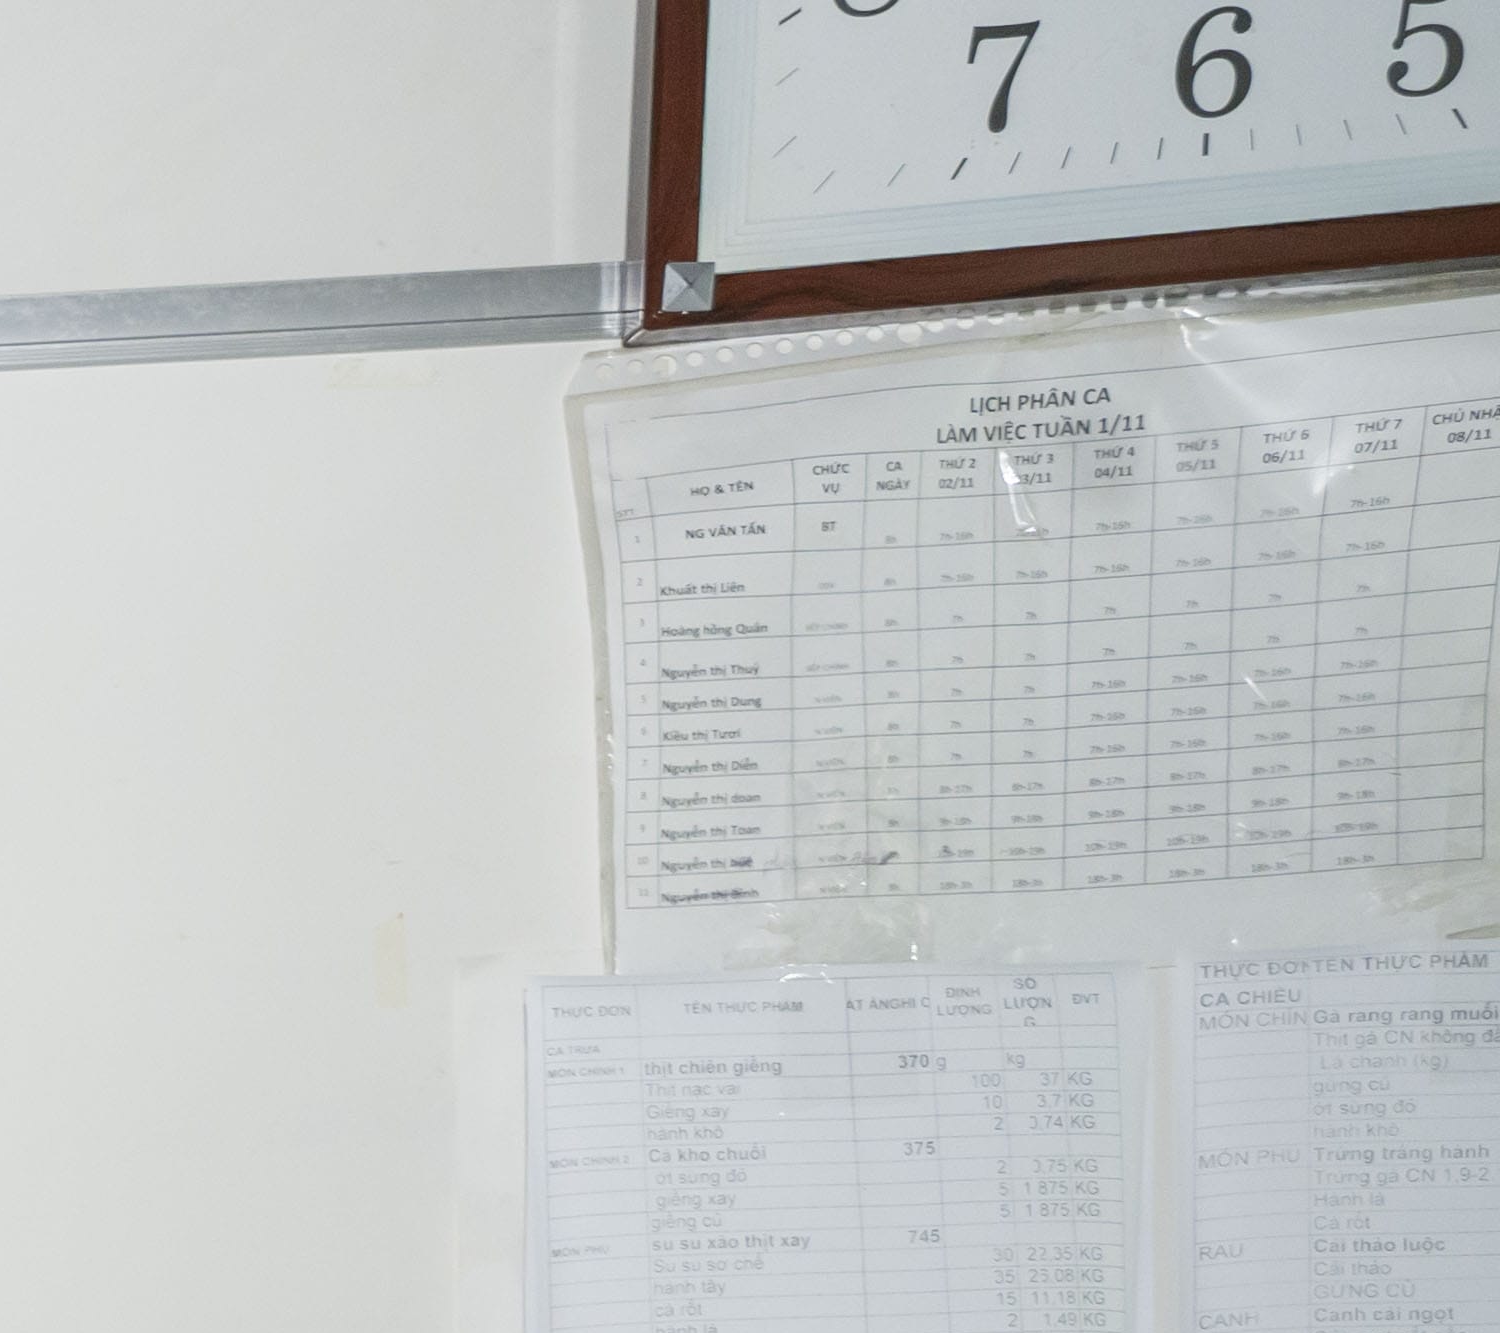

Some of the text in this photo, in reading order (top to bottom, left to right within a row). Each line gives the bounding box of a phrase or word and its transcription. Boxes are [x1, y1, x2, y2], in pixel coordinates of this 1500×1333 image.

[967, 19, 1041, 133] 7
[1174, 5, 1254, 118] 6
[1386, 0, 1466, 97] 5
[936, 414, 1146, 444] LÀM VIỆC TUẦN 1/11
[970, 387, 1112, 416] LỊCH PHÂN CA
[908, 1229, 941, 1244] 745
